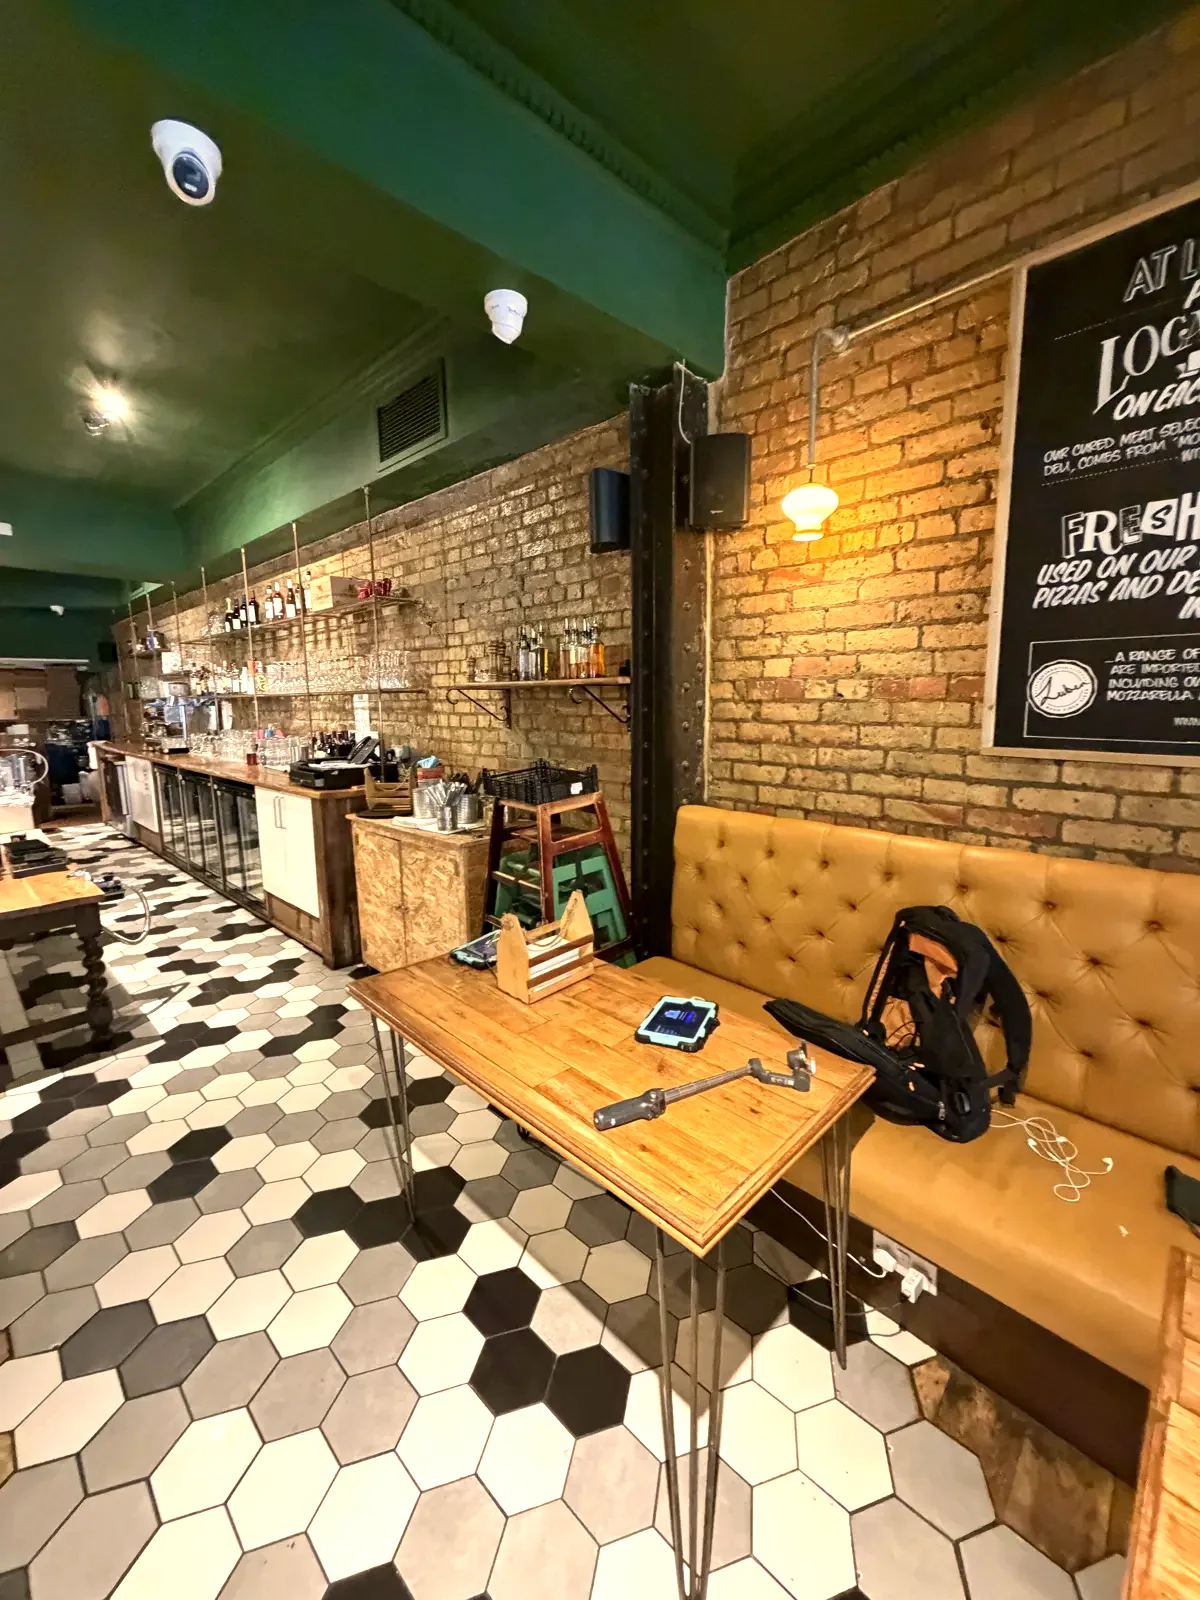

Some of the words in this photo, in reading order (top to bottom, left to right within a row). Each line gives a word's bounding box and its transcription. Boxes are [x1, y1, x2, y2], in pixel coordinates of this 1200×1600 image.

[1123, 244, 1178, 302] AT
[1180, 238, 1200, 280] L
[1113, 389, 1159, 421] ON
[1043, 446, 1070, 463] OUR
[1071, 437, 1115, 457] CURED
[1119, 426, 1158, 448] MEAT
[1077, 449, 1121, 470] COMES
[1125, 440, 1167, 460] FROM
[1036, 558, 1093, 586] USED
[1096, 552, 1139, 579] ON
[1138, 544, 1198, 574] OUR
[1031, 580, 1109, 609] PIZZAS
[1107, 574, 1165, 602] AND
[1109, 664, 1137, 676] ARE
[1128, 648, 1176, 662] RANGE
[1106, 689, 1195, 702] MOZZARELLA
[1107, 676, 1180, 689] INCLUDING
